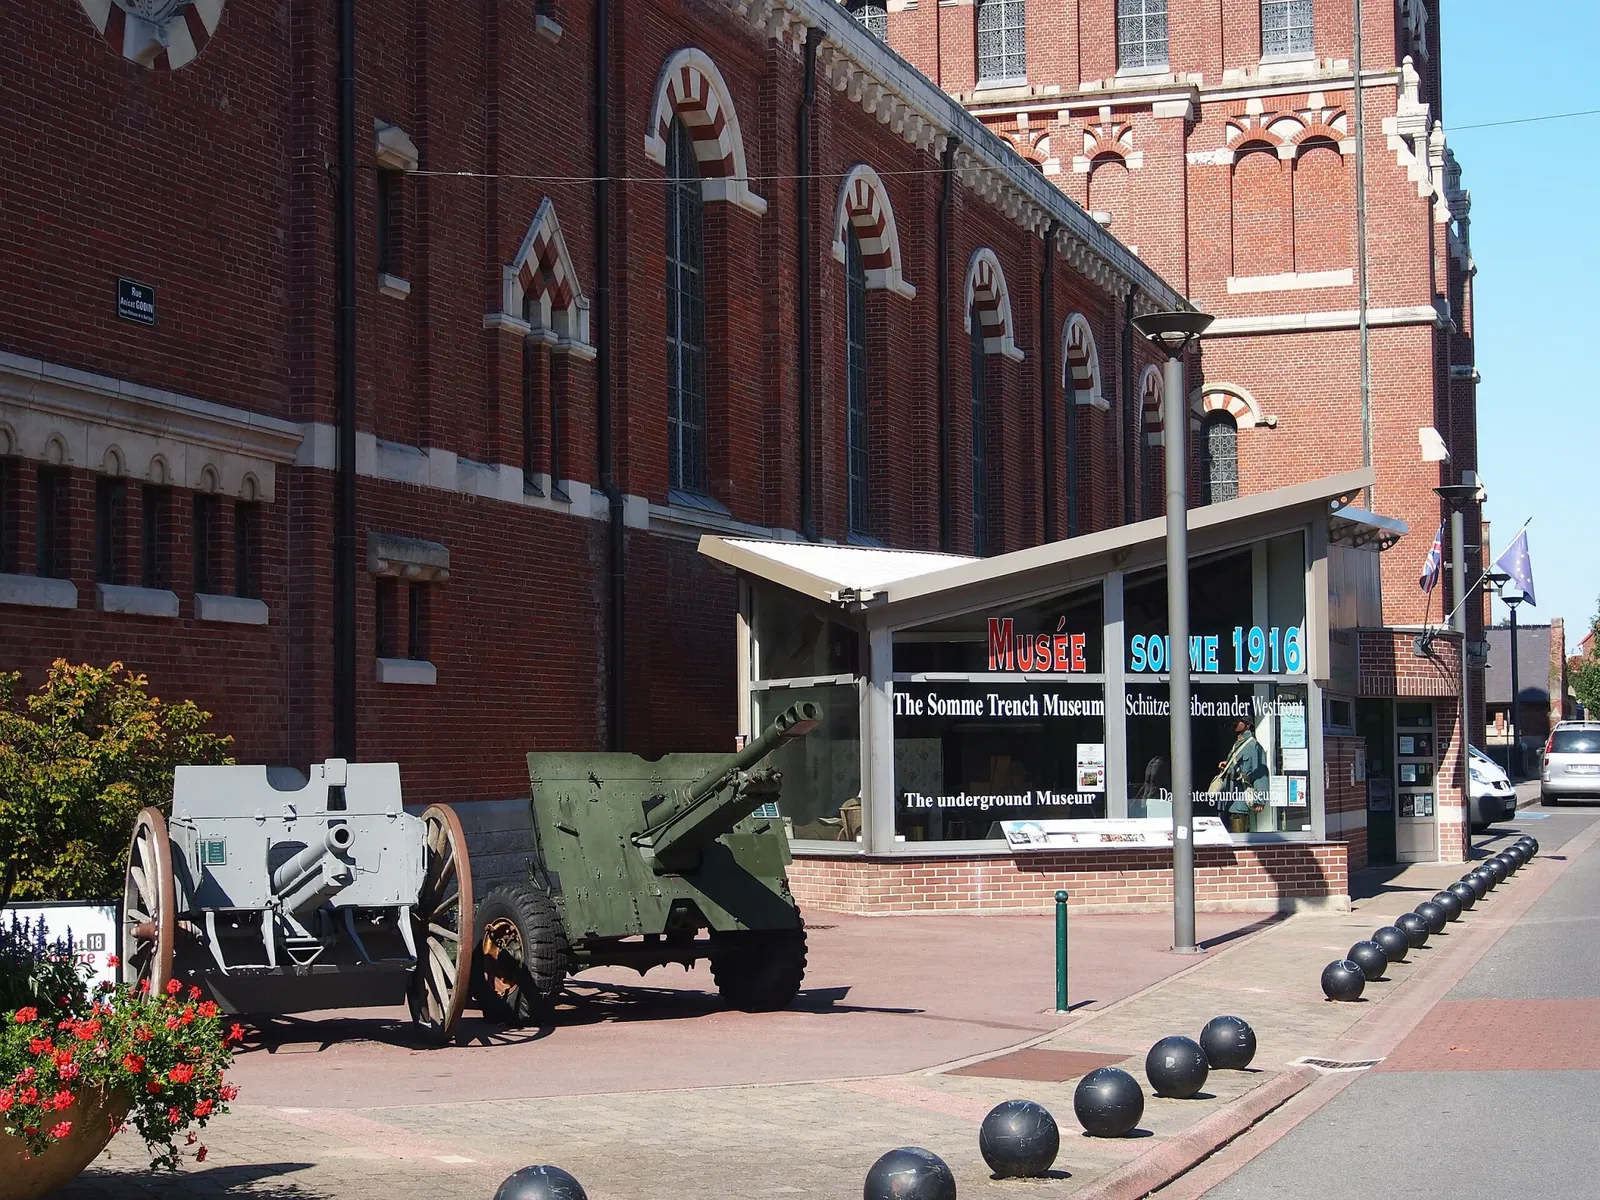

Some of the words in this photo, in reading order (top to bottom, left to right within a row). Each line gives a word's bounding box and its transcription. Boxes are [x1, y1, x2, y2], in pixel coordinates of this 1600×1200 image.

[131, 286, 142, 298] Rue
[1232, 626, 1300, 673] 1916
[893, 692, 924, 716] The
[927, 692, 984, 717] Somme
[986, 693, 1039, 717] Trench
[1043, 693, 1105, 716] Museum
[1216, 701, 1231, 717] an
[1231, 694, 1251, 717] der
[1251, 694, 1305, 718] Westfront
[904, 792, 934, 808] The
[937, 791, 1032, 811] underground
[1035, 790, 1096, 807] Museum
